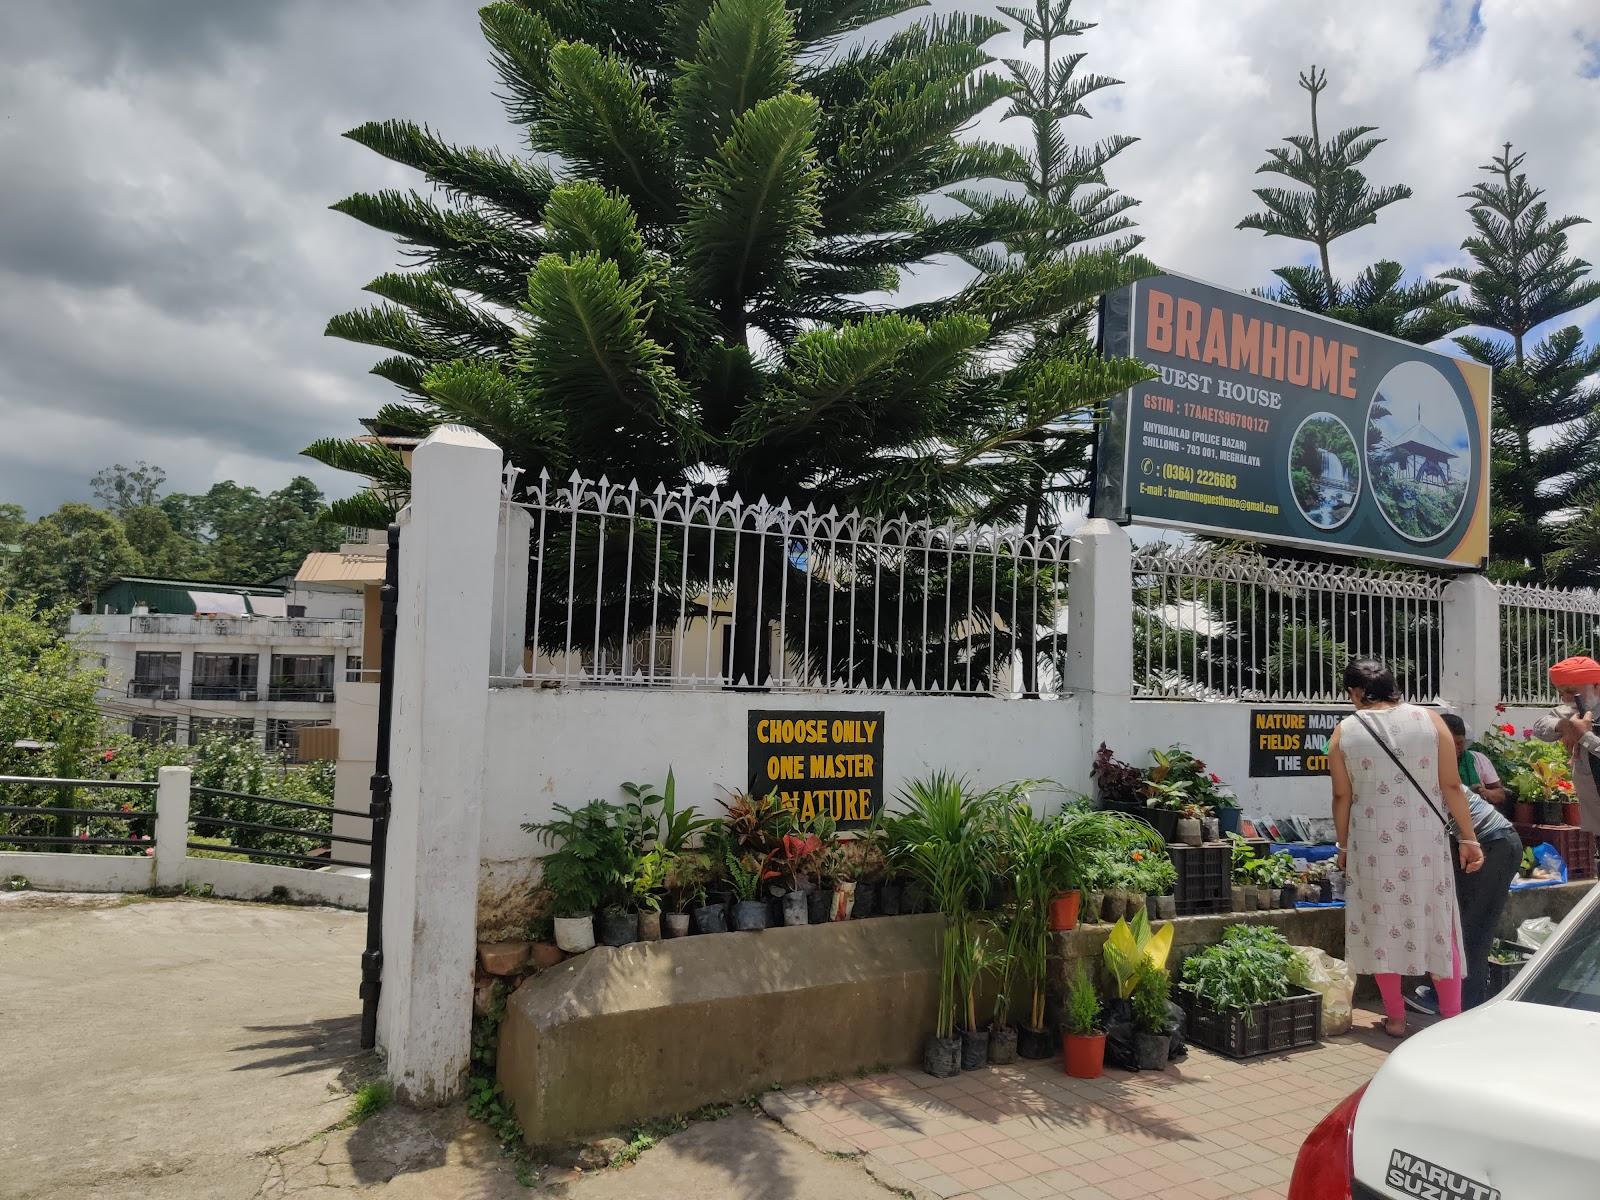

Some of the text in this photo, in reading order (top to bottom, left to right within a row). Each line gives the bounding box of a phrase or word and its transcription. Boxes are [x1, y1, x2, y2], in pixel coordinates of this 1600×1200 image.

[1147, 289, 1359, 399] BRAMHOME
[1143, 394, 1174, 414] GSTIN
[1217, 379, 1282, 410] HOUSE
[1143, 421, 1247, 452] KHYNDAILAD (POLICE BAZAR)
[1142, 436, 1180, 452] SHILLONG
[1186, 444, 1201, 456] 793
[1202, 448, 1218, 460] 001,
[1219, 450, 1261, 467] MEGHALAYA
[1162, 463, 1194, 484] (0364)
[1196, 469, 1237, 490] 2226683
[1139, 482, 1163, 497] E-mail
[1168, 486, 1279, 515] bramhomeguesthouse@gmail.com
[756, 719, 877, 744] CHOOSE ONLY
[1256, 713, 1305, 729] NATURE
[1259, 734, 1328, 750] FIELDS AND
[767, 754, 874, 780] ONE MASTER
[1275, 755, 1330, 771] THE CIT
[781, 788, 873, 823] NATURE
